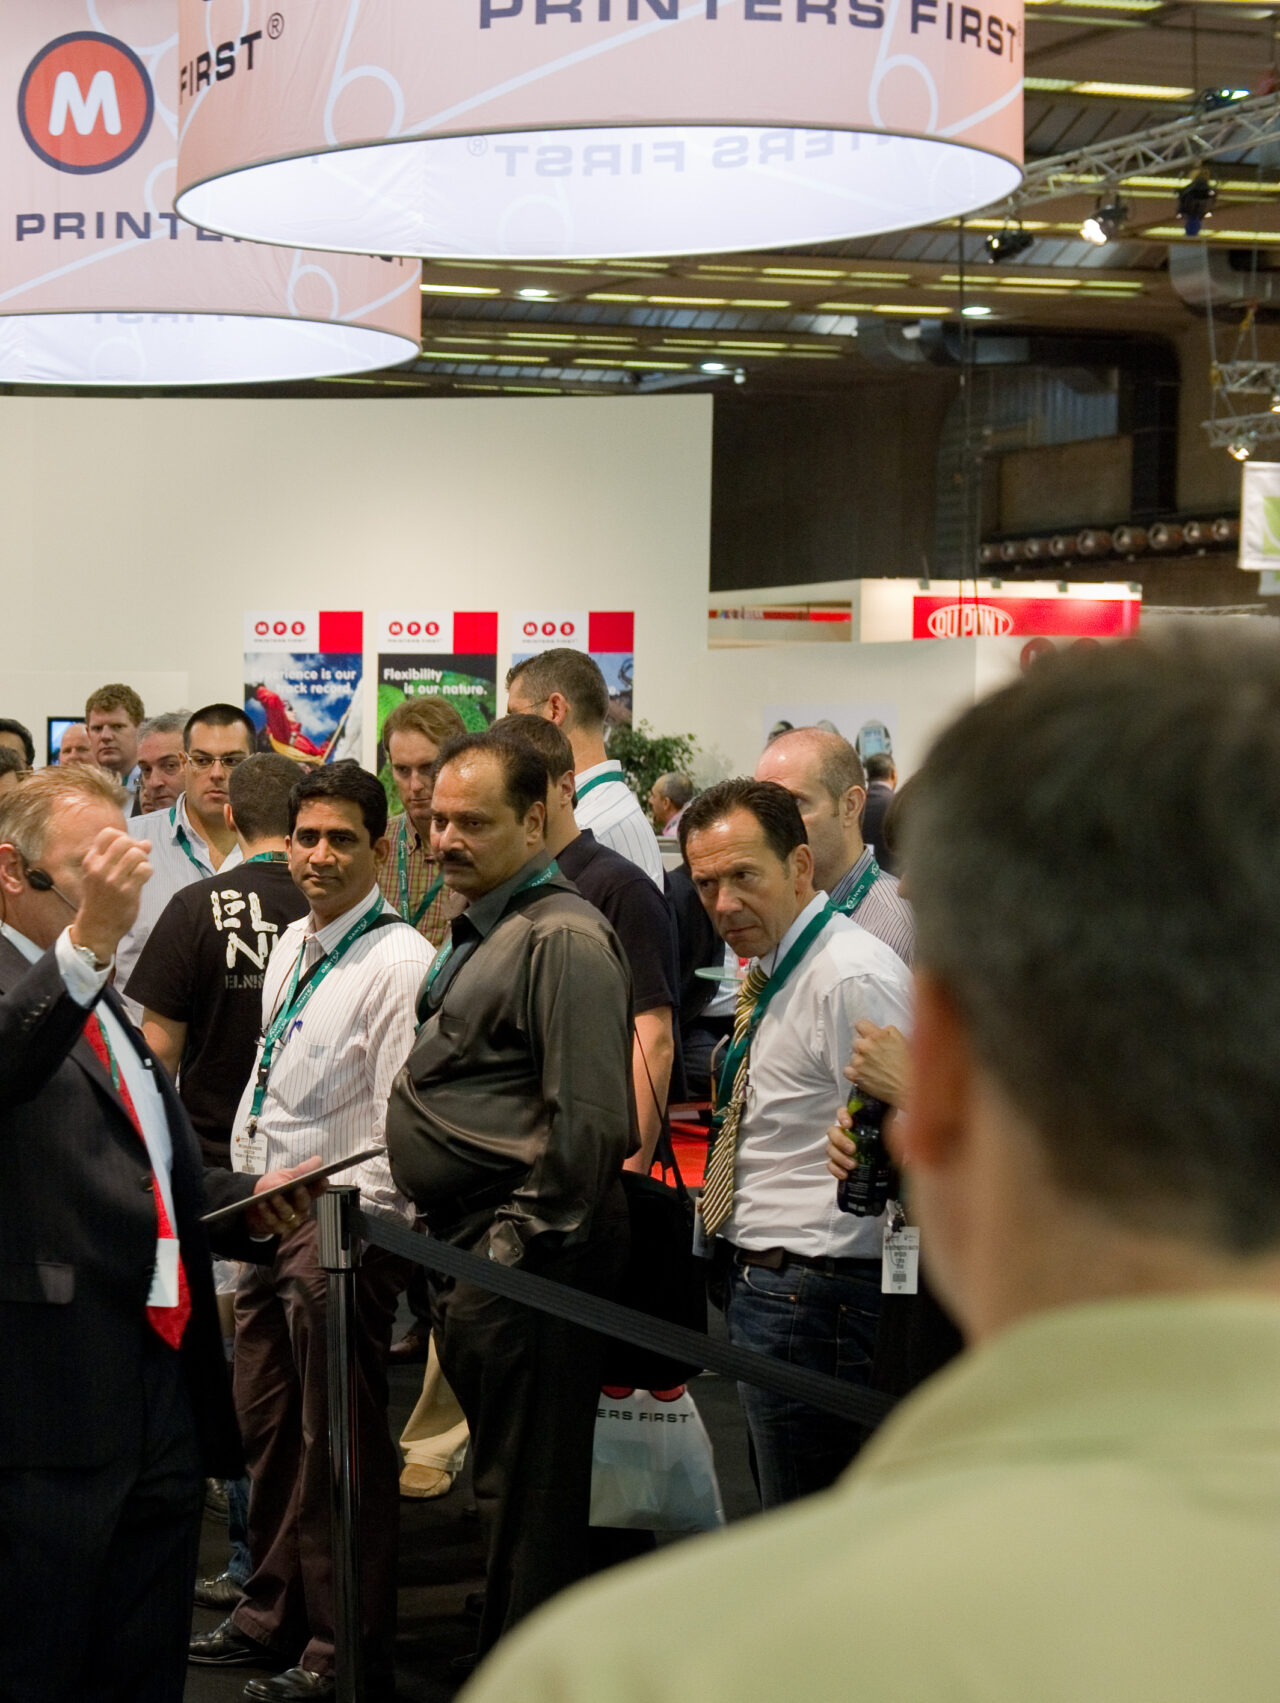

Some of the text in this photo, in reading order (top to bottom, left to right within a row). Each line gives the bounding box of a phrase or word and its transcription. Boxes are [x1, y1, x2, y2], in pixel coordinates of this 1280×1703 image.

[910, 0, 1017, 63] FIRST
[48, 70, 122, 136] M
[321, 668, 332, 679] is
[335, 670, 357, 680] our
[383, 667, 443, 683] Flexibility
[403, 682, 414, 695] is
[418, 684, 440, 695] our
